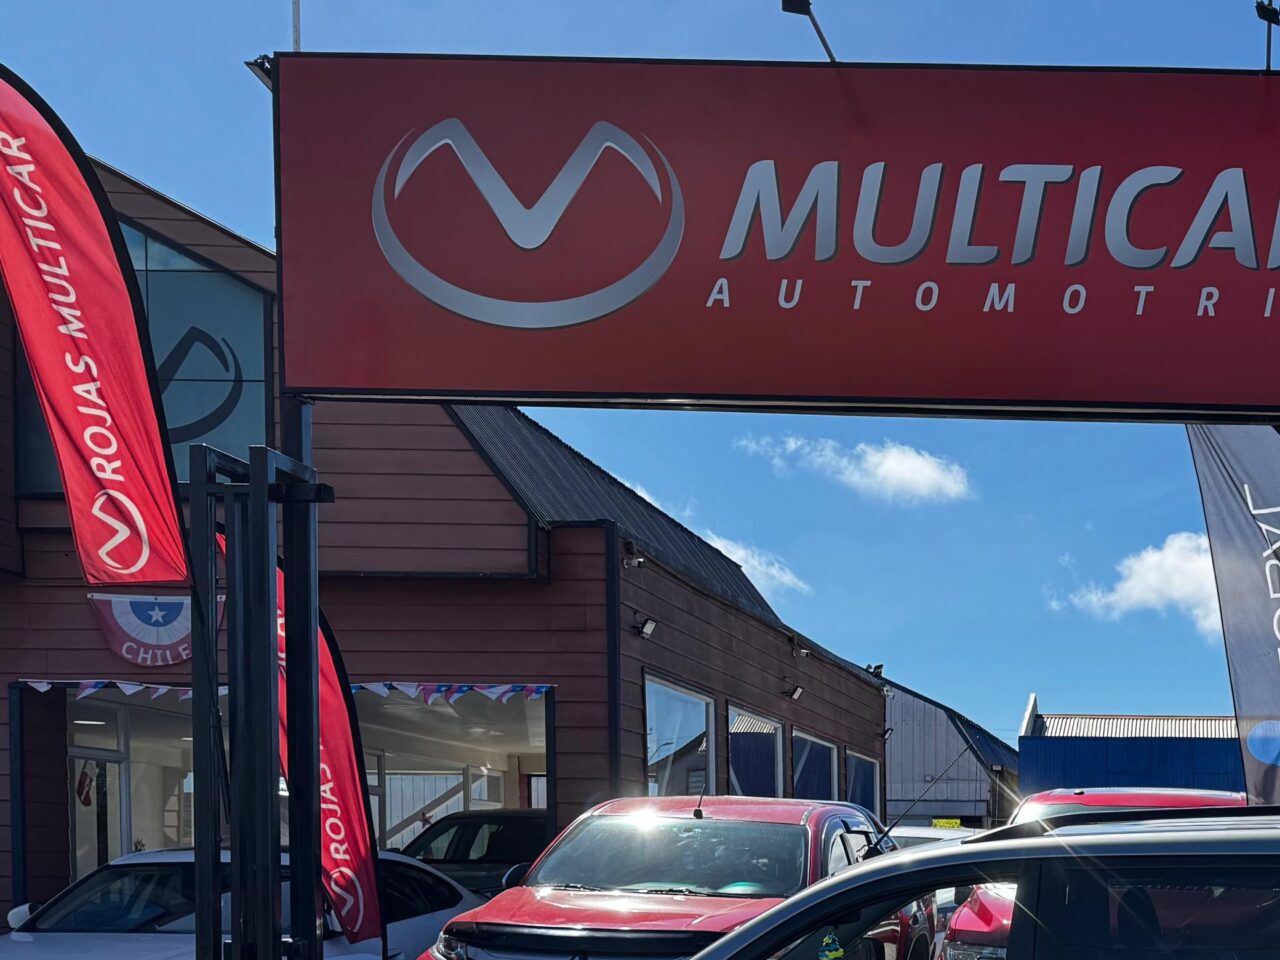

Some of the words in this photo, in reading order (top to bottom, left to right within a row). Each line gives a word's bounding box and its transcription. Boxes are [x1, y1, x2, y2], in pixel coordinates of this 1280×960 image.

[0, 130, 89, 340] MULTICAR
[65, 351, 125, 483] ROJAS
[121, 641, 193, 666] CHILE
